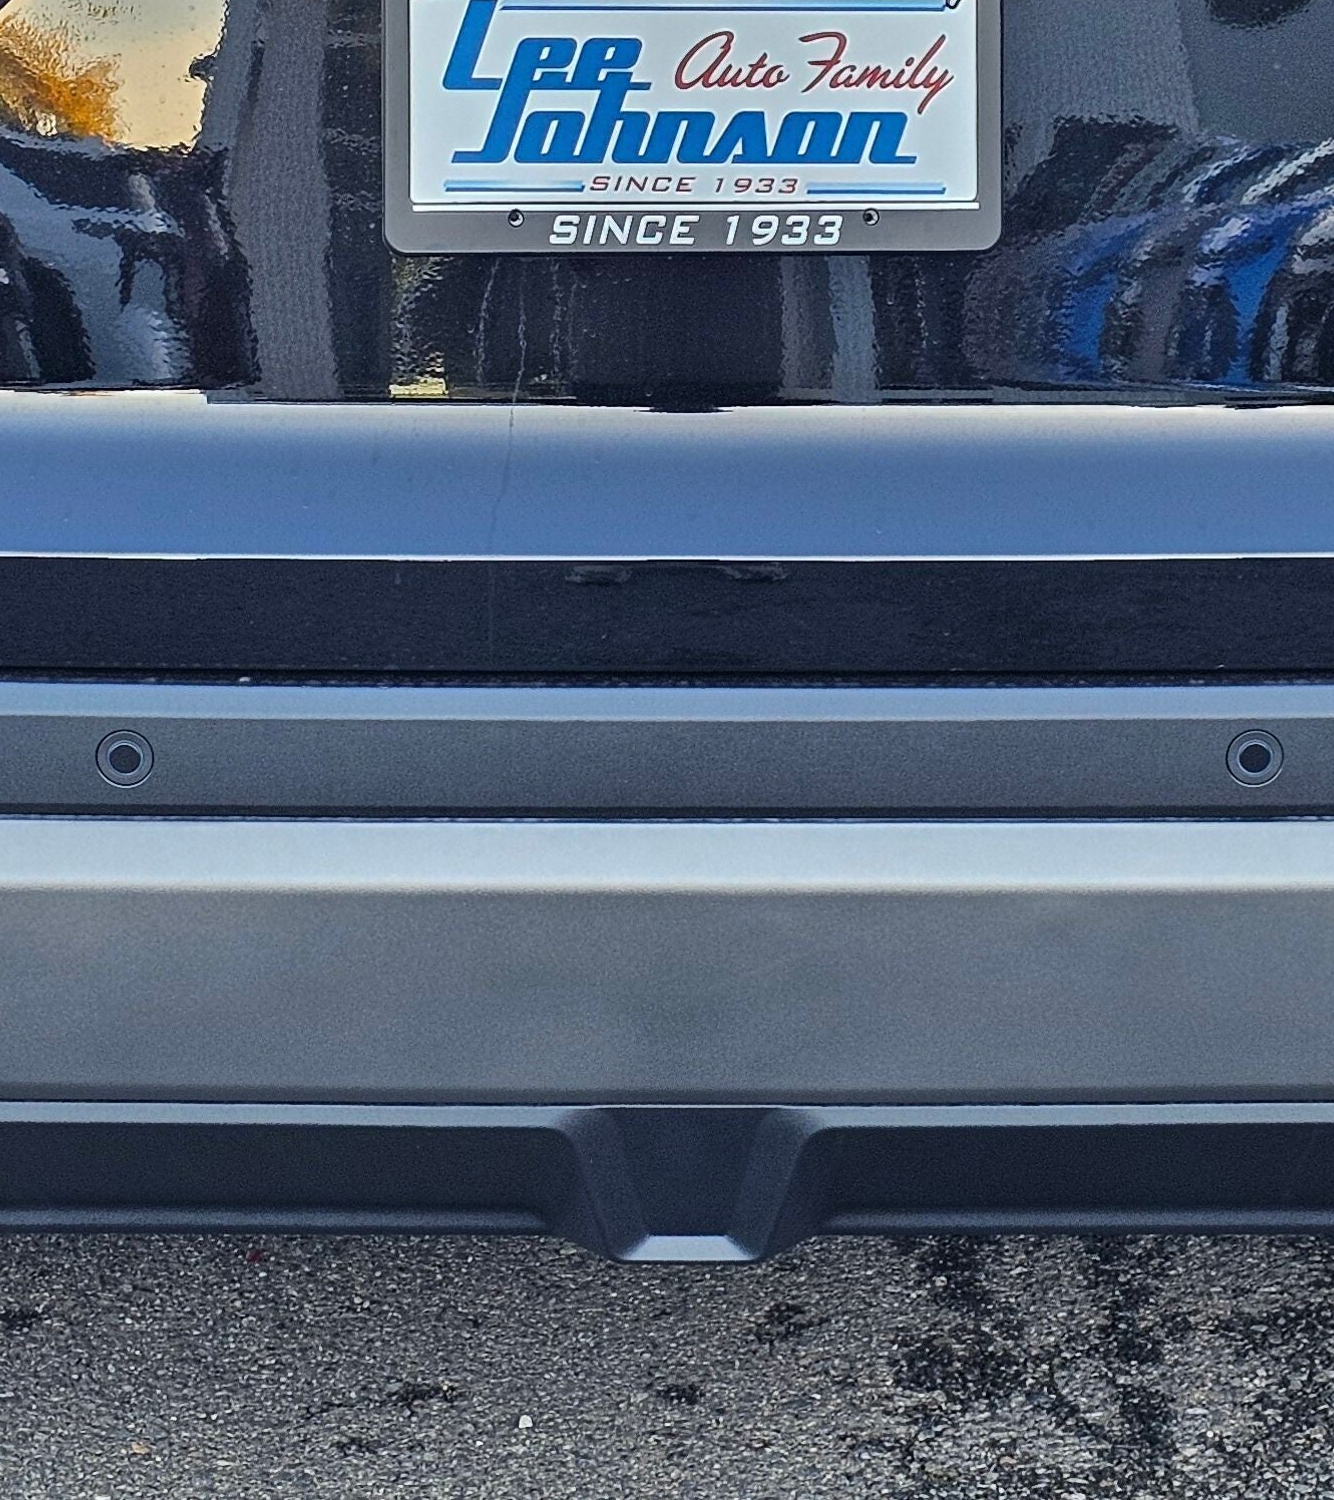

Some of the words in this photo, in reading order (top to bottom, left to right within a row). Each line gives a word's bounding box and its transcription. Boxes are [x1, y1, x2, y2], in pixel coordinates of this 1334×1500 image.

[442, 0, 652, 90] Lee
[675, 30, 790, 90] Auto
[798, 31, 955, 116] Family
[451, 72, 917, 164] Johnson
[589, 175, 697, 193] SINCE
[714, 176, 799, 194] 1933
[548, 214, 700, 246] SINCE
[725, 214, 844, 246] 1933
